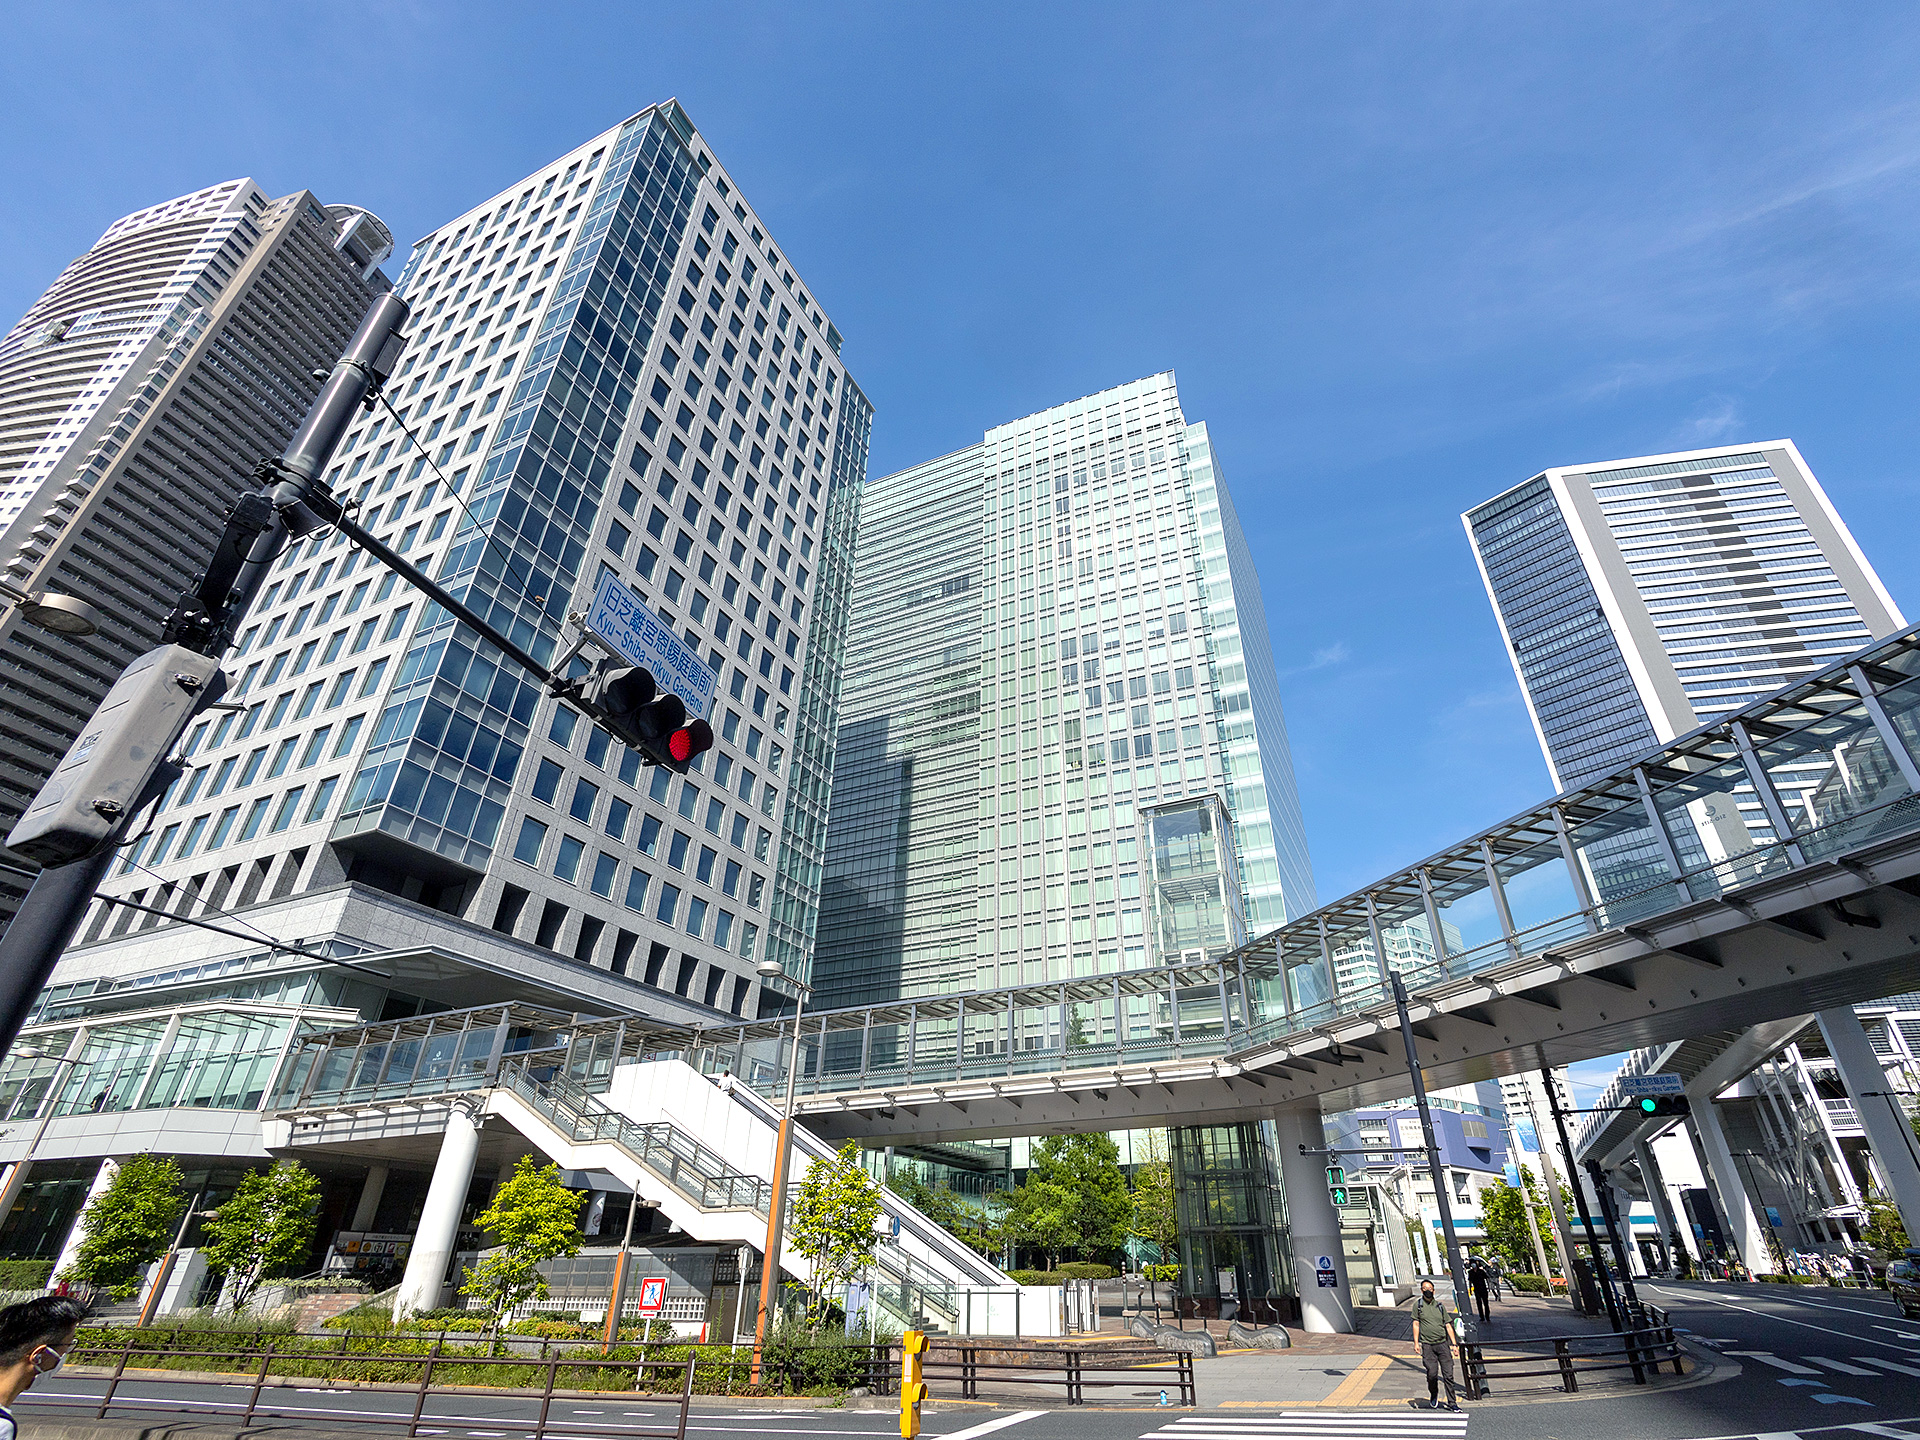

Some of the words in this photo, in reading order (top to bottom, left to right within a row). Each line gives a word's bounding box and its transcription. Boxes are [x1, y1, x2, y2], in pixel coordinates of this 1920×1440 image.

[602, 582, 713, 697] 旧芝離宮恩賜庭園前
[672, 675, 704, 713] Gardens
